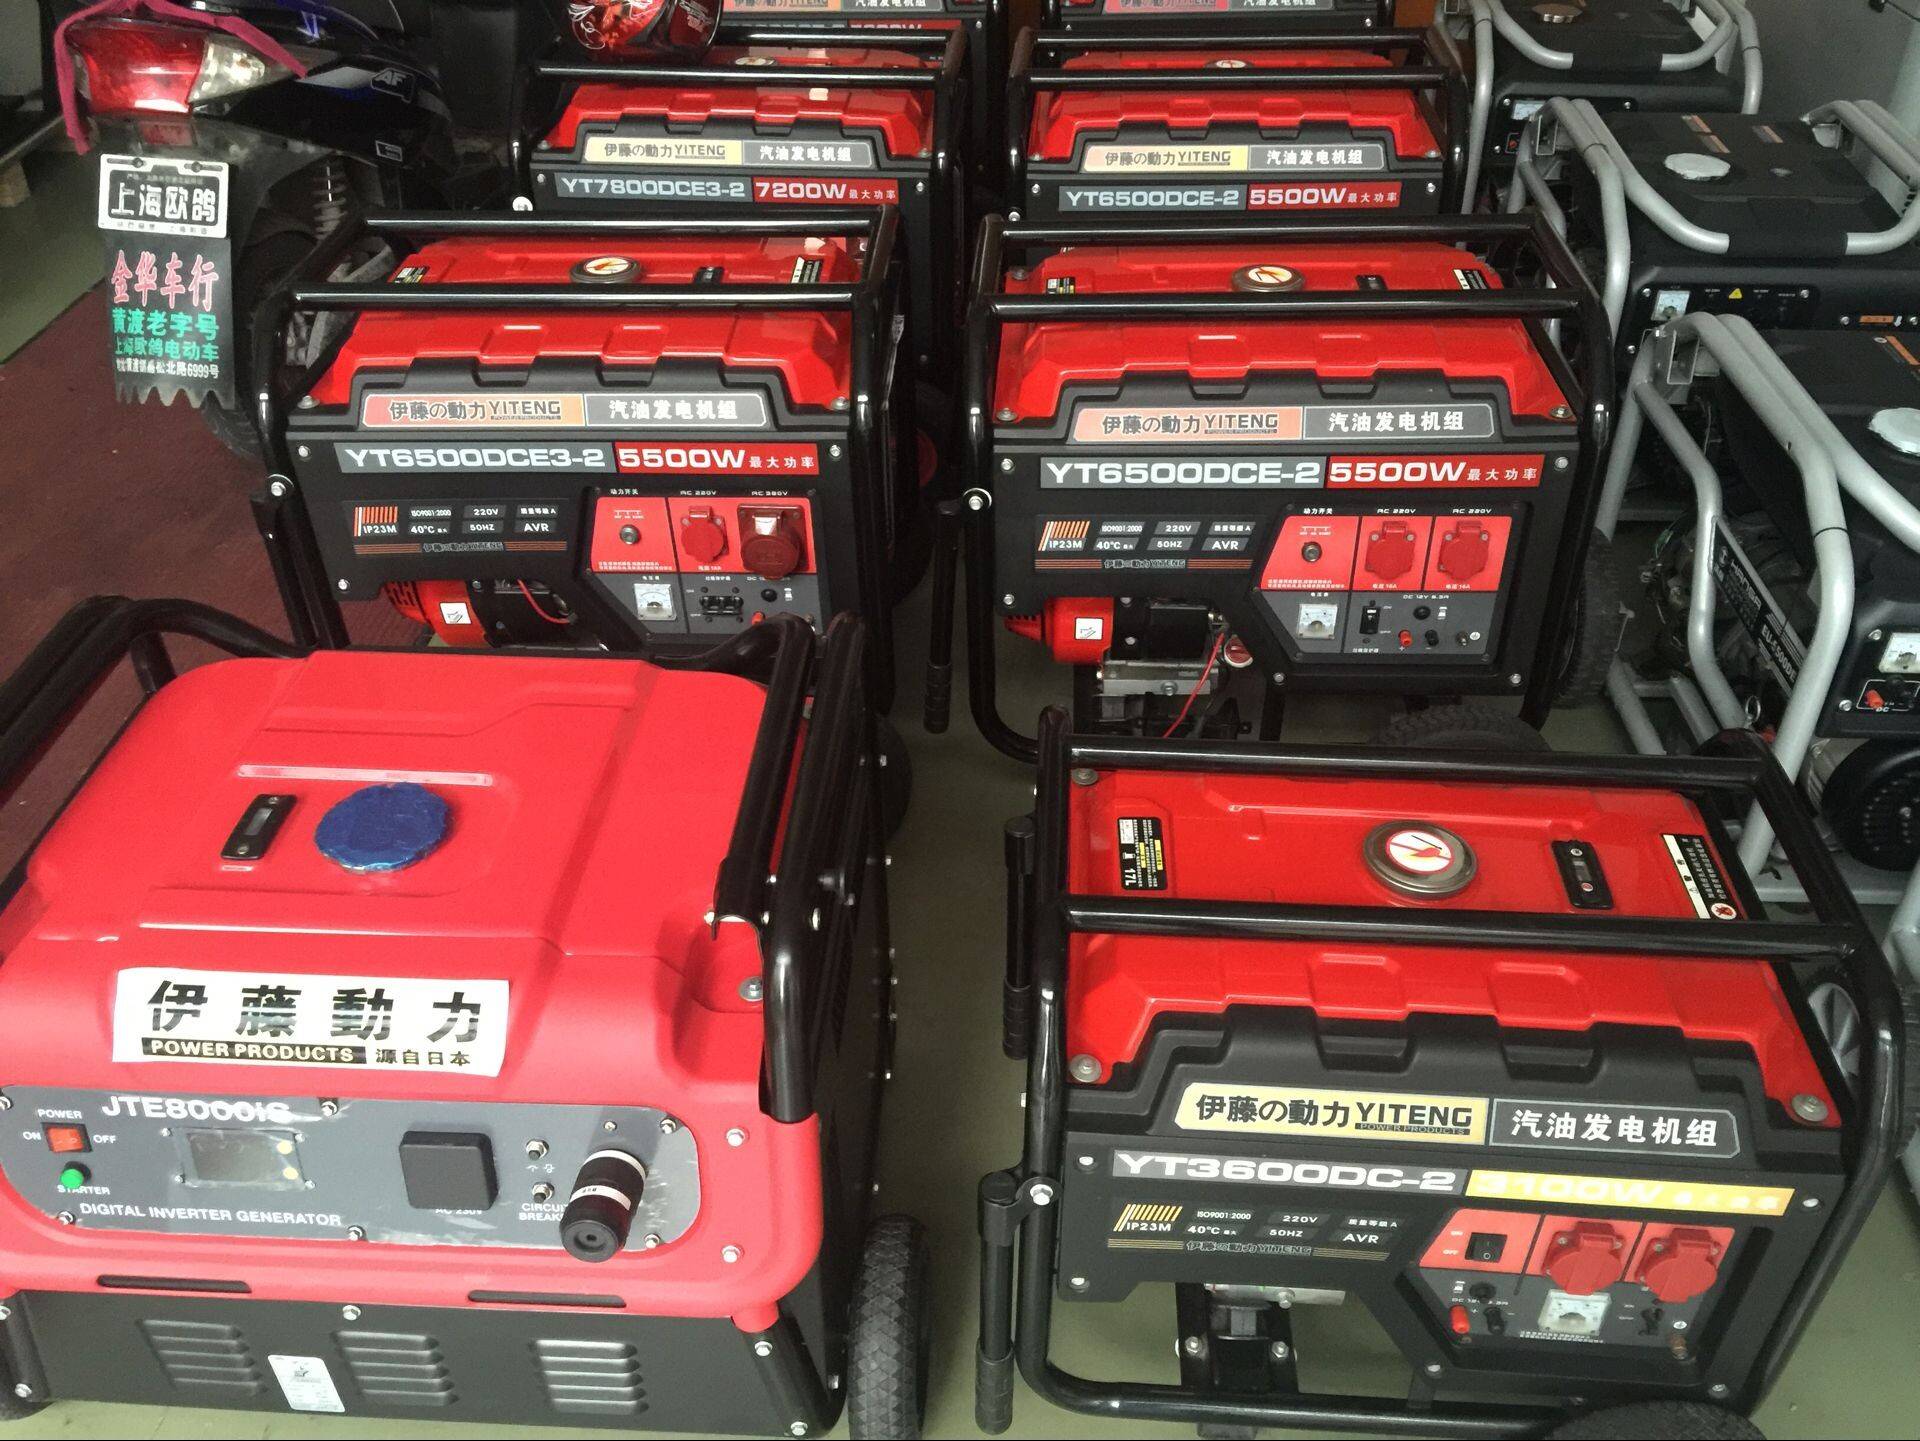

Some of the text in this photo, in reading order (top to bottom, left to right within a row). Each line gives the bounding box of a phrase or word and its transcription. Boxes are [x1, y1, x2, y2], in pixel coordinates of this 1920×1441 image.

[674, 144, 726, 157] YITENG
[760, 145, 852, 162] 汽油发电机组
[1178, 150, 1231, 162] YITENG
[1267, 150, 1363, 166] 汽油发电机组
[561, 177, 745, 198] YT7800DCE3-2
[755, 182, 896, 200] 7200W 最大功率
[1250, 187, 1397, 205] 5500W 最大功率
[111, 182, 216, 222] 上海欧鸽
[1066, 189, 1239, 207] YT6500DCE-2
[111, 249, 219, 312] 金华车行
[112, 307, 219, 340] 黄渡老字号
[115, 336, 219, 361] 上海欧鸽电动车
[390, 401, 560, 420] 伊藤の動力 YITENG
[609, 400, 738, 420] 汽油发电机组
[1102, 414, 1278, 434] 伊藤の動力 YITENG
[1329, 411, 1464, 432] 汽油发电机组
[345, 448, 605, 467] YT6500DCE3-2
[618, 448, 814, 469] 5500W 最大功率
[1047, 462, 1319, 483] YT6500DCE-2
[1330, 462, 1537, 482] 5500W 最大功率
[473, 508, 499, 516] 220V
[363, 524, 398, 534] IP23M
[524, 523, 550, 532] AVR
[1049, 540, 1082, 549] IP23M
[1212, 541, 1239, 549] AVR
[147, 979, 482, 1044] 伊藤動力
[151, 1038, 354, 1063] POWER PRODUCTS
[376, 1048, 471, 1067] 源自日本
[37, 1108, 82, 1119] POWER
[1196, 1094, 1473, 1128] 伊藤の動力 YITENG
[23, 1131, 41, 1141] ON
[1511, 1109, 1718, 1147] 汽油发电机组
[93, 1134, 116, 1144] OFF
[1117, 1153, 1456, 1191] YT3600DC-2
[57, 1184, 110, 1195] STARTER
[1478, 1172, 1664, 1201] 3100W
[80, 1202, 342, 1226] DIGITAL INVERTER GENERATOR
[1282, 1215, 1318, 1223] 220V
[1126, 1222, 1172, 1232] IP23M
[1269, 1229, 1304, 1237] 50HZ
[1343, 1233, 1379, 1244] AVR
